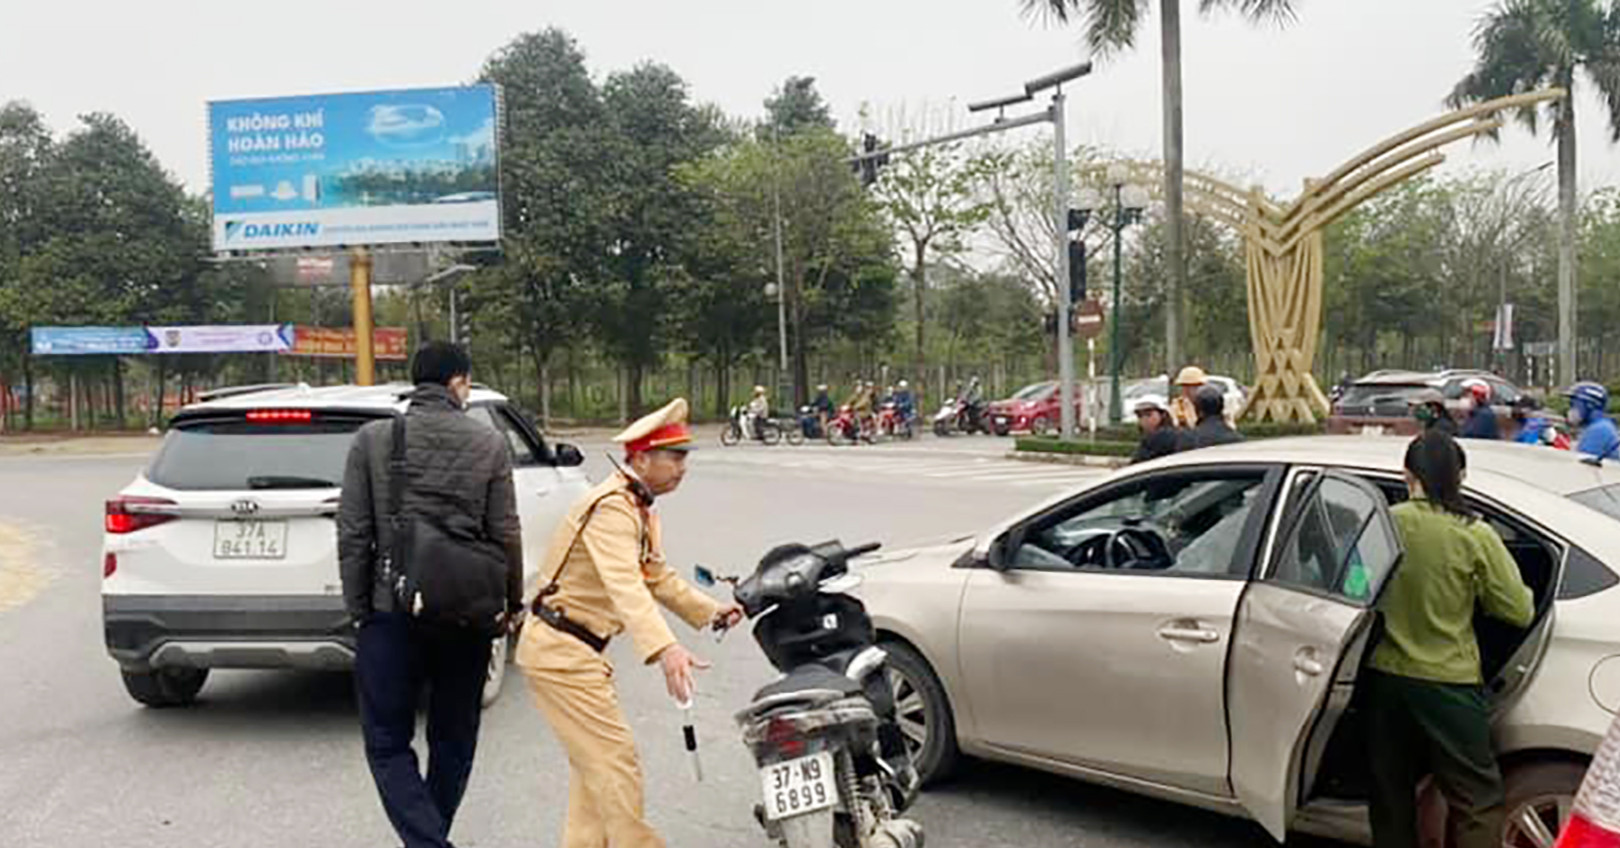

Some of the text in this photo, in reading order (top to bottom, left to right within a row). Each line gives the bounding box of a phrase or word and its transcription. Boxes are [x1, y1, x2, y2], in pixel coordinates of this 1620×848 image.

[244, 223, 319, 237] DAIKIN
[235, 522, 265, 538] 37A
[776, 782, 825, 812] 6899
